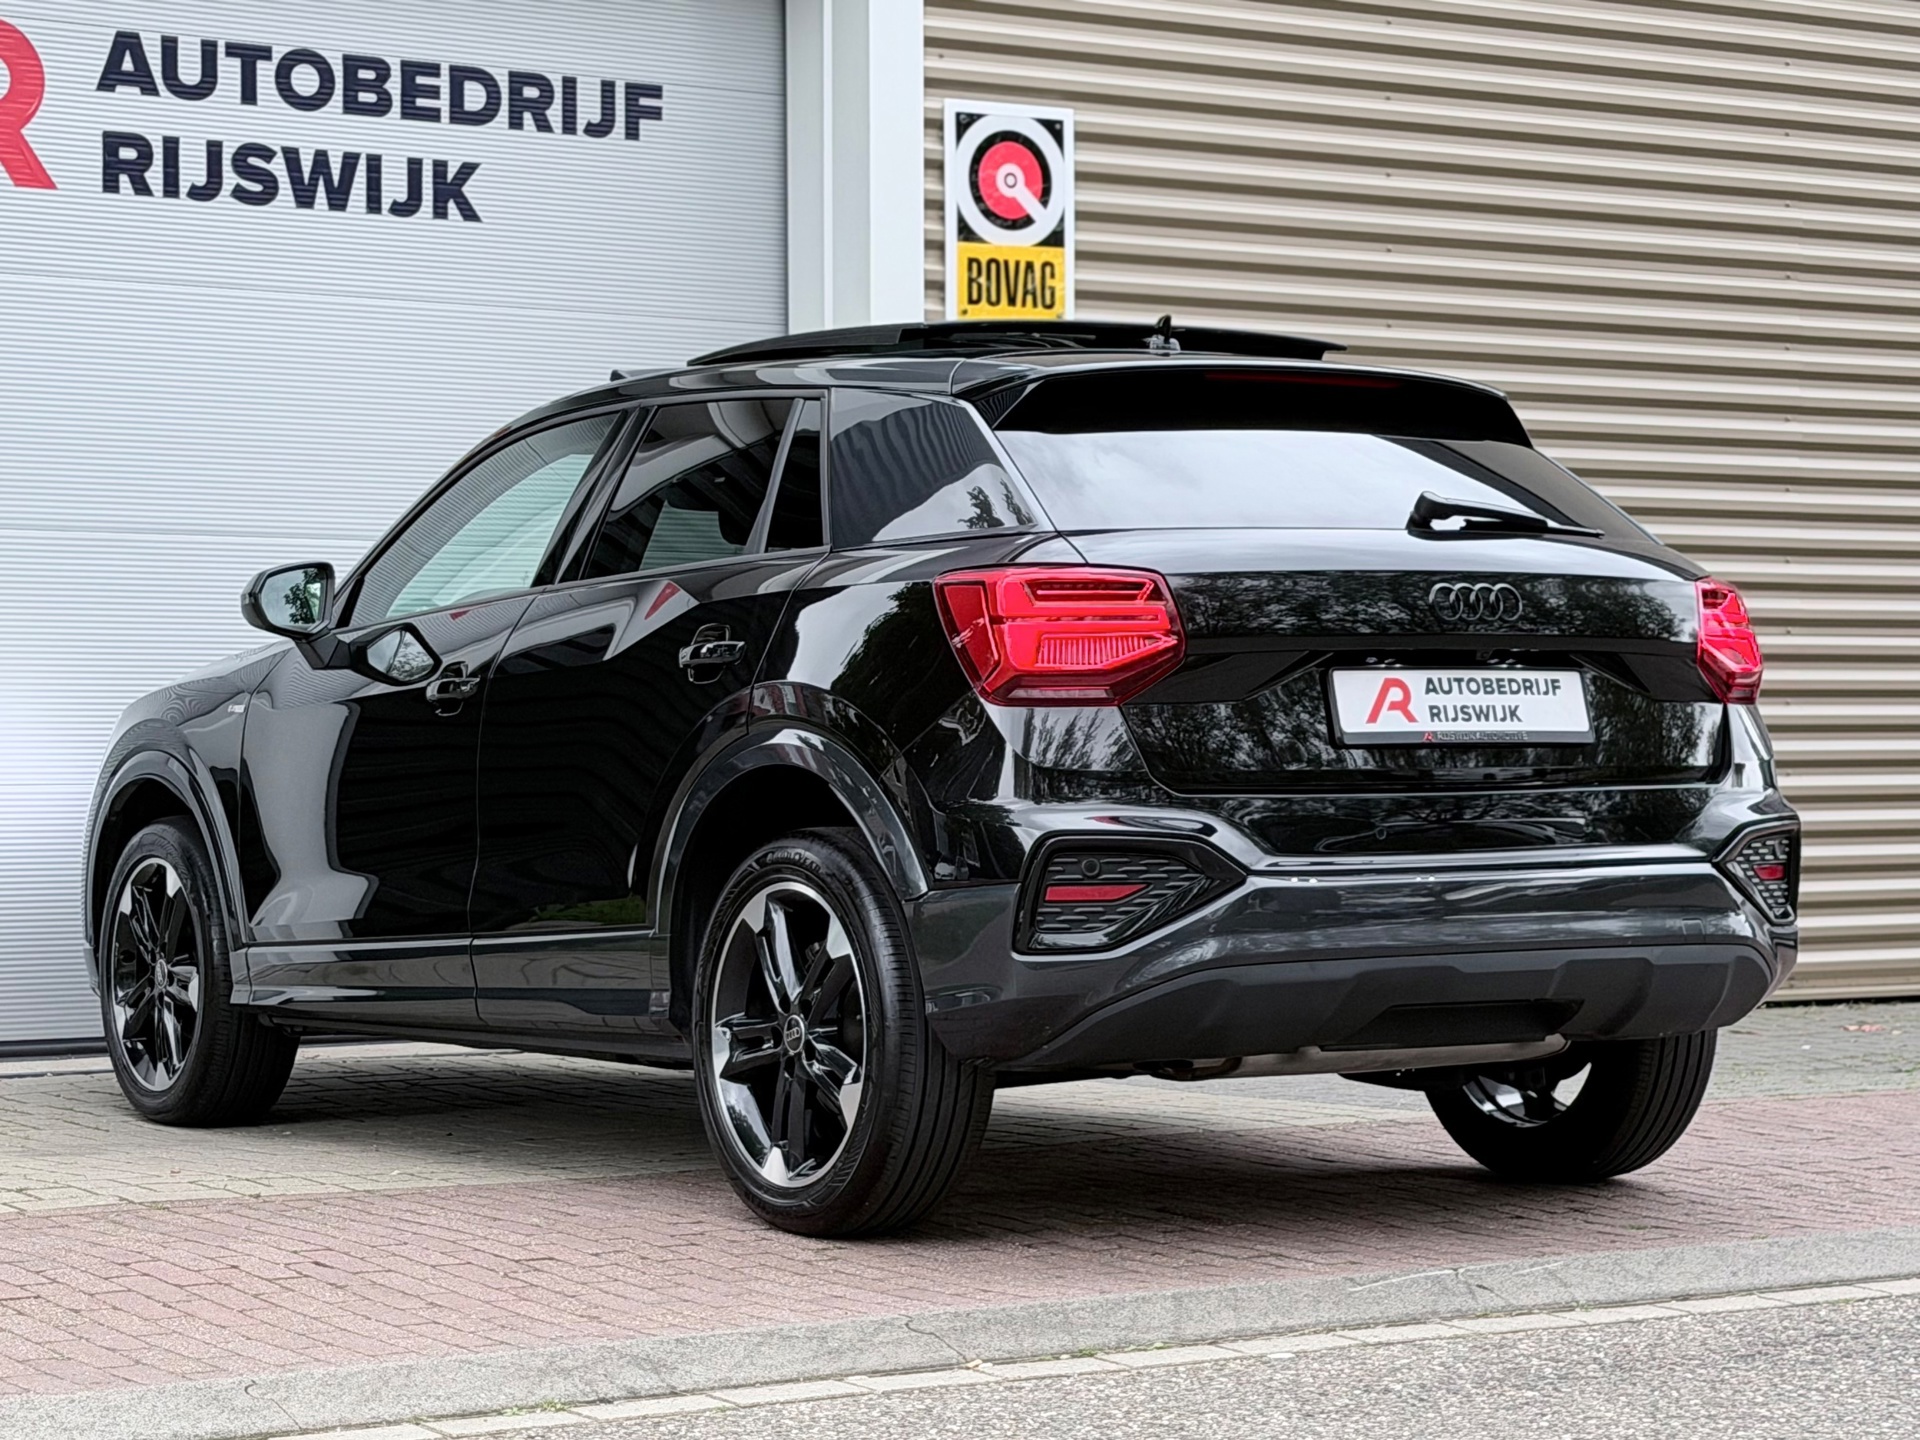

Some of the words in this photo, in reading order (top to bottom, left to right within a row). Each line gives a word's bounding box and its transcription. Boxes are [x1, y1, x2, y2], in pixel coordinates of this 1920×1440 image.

[96, 31, 663, 141] AUTOBEDRIJF
[102, 131, 482, 223] RIJSWIJK
[967, 258, 1056, 310] BOVAG
[1424, 677, 1561, 696] AUTOBEDRIJF
[1429, 704, 1522, 723] RIJSWIJK
